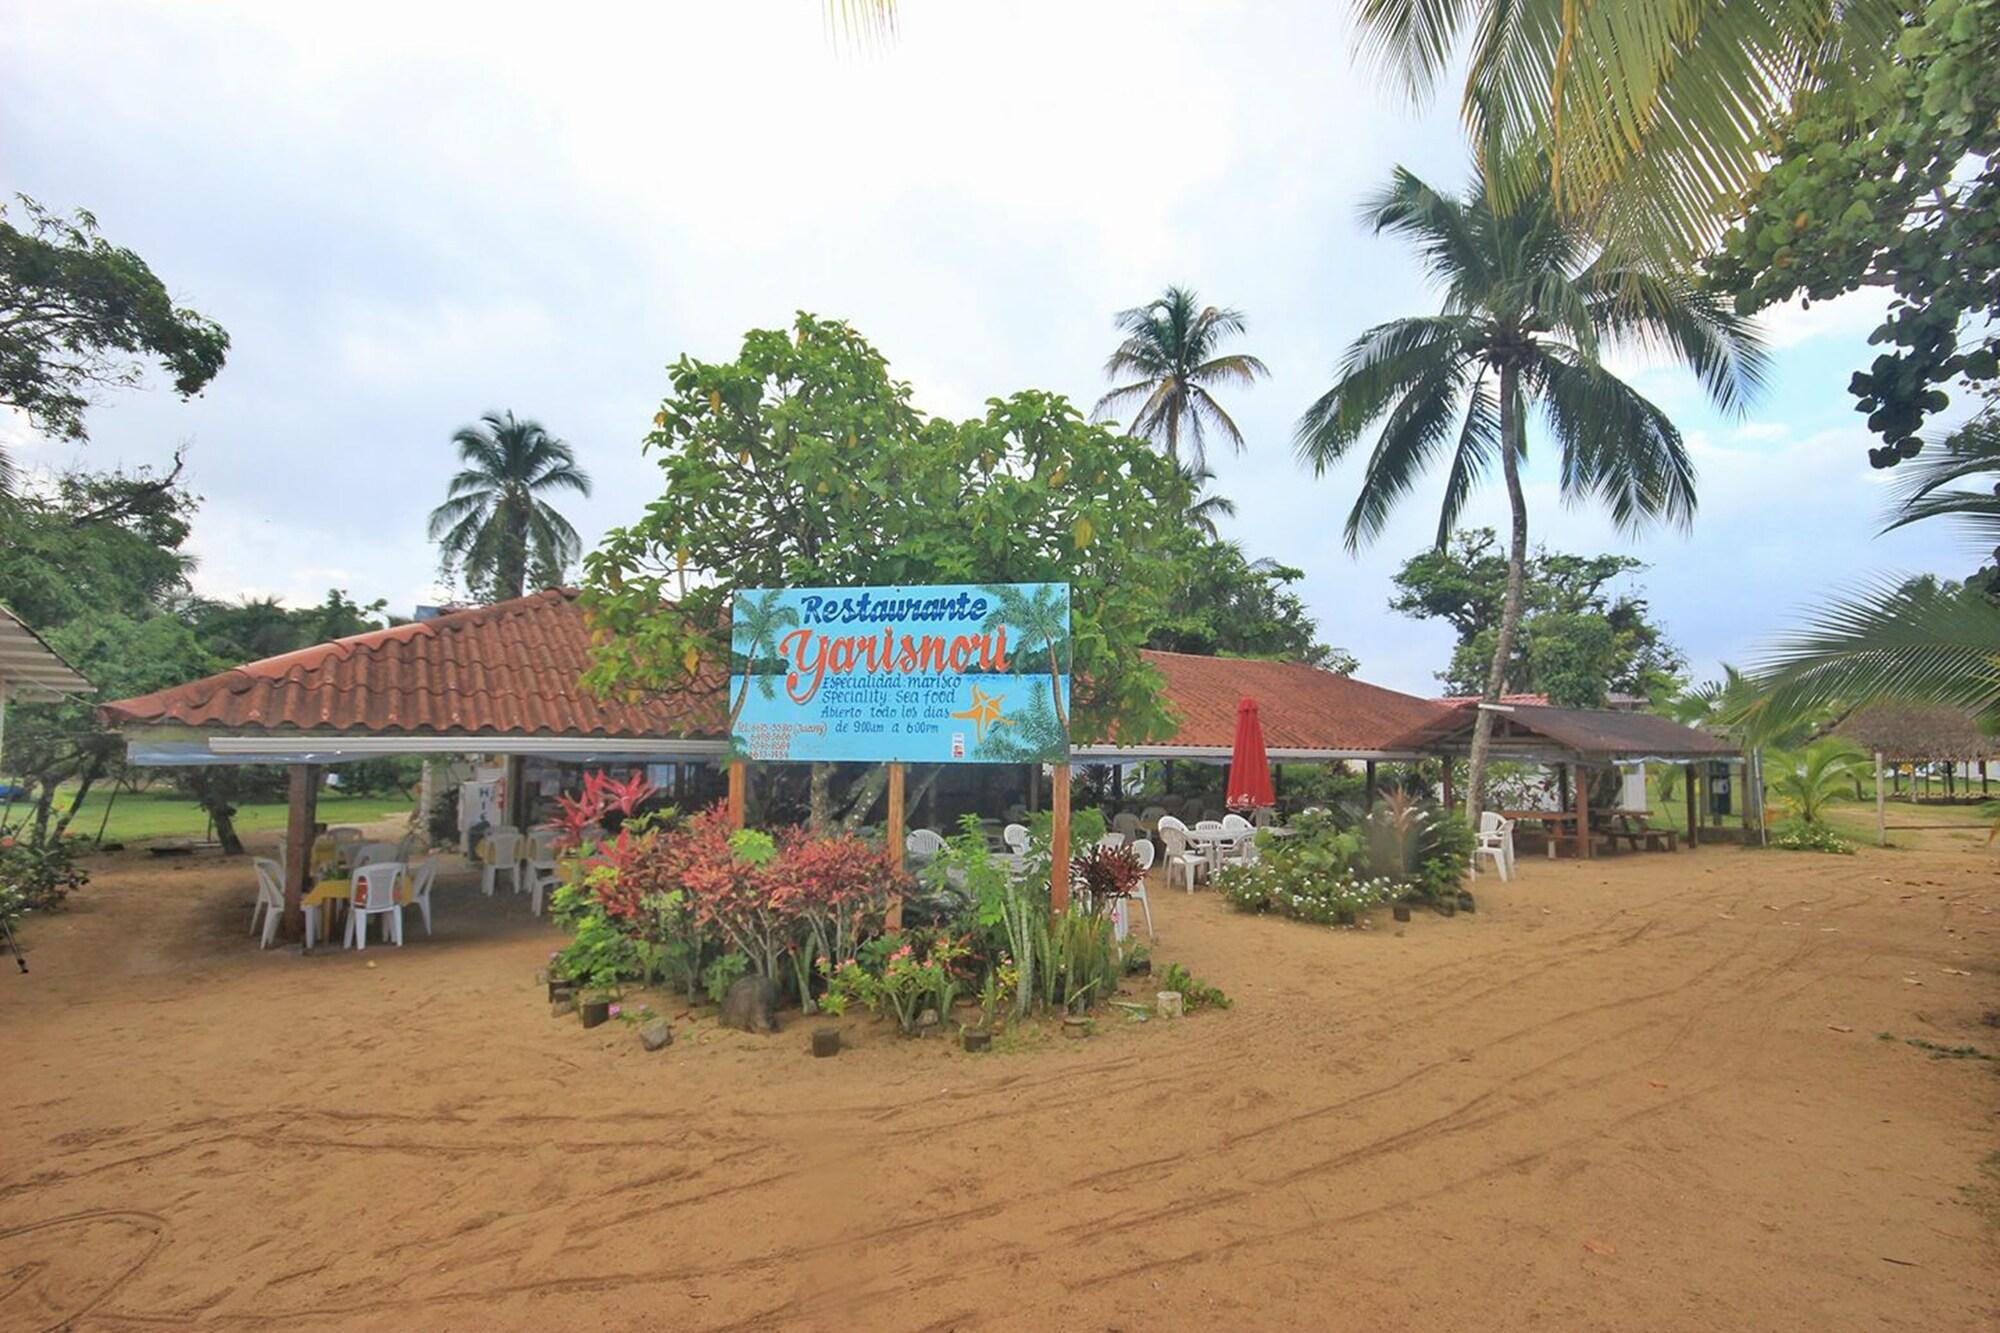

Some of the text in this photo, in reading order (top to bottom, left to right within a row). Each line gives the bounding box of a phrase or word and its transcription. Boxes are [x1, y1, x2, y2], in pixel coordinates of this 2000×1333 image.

[801, 592, 988, 624] Restaurante
[779, 625, 1012, 704] Yarisnori
[908, 676, 961, 689] marisco
[895, 690, 919, 704] Sea
[923, 689, 955, 705] food
[820, 705, 862, 718] Abierto
[870, 706, 897, 718] todo
[901, 706, 918, 718] los
[835, 720, 848, 733] de
[891, 722, 900, 733] a
